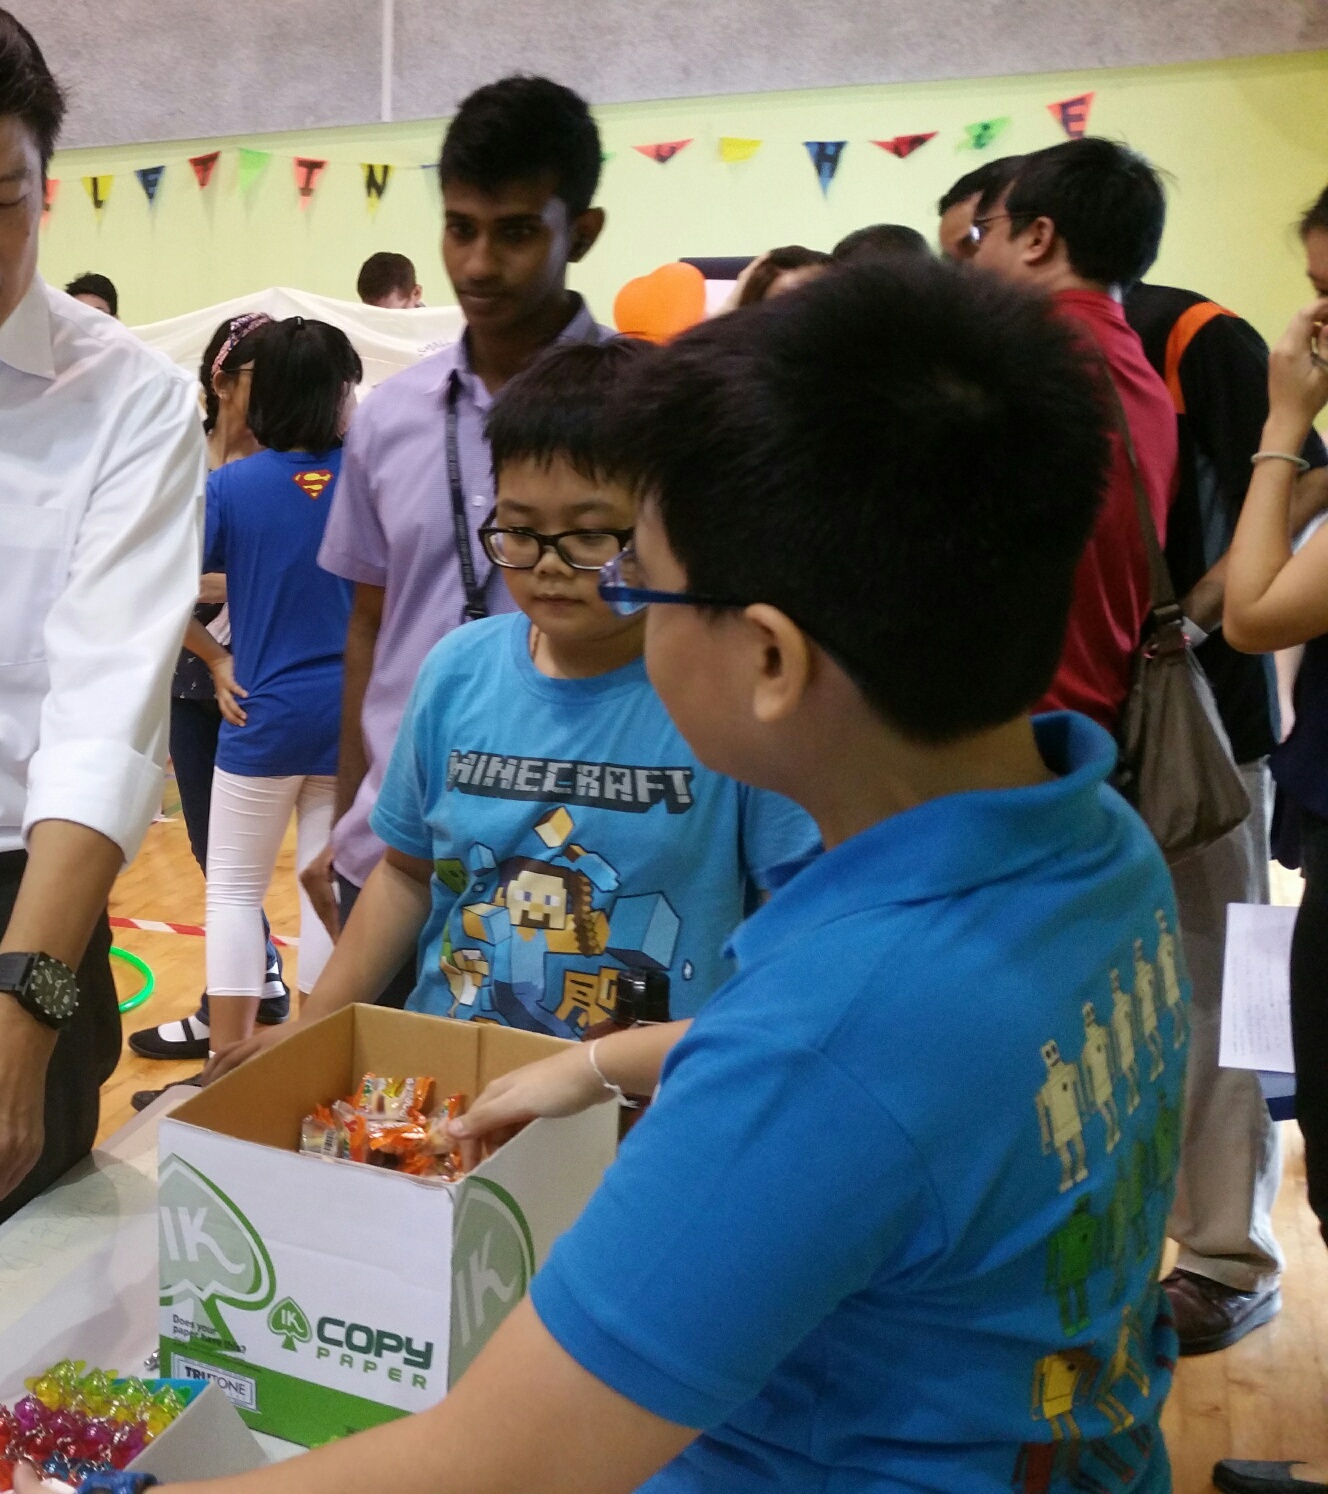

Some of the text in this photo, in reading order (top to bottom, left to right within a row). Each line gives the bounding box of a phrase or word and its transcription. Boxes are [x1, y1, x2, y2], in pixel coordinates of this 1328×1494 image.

[446, 749, 692, 810] MINECRAFT
[159, 1206, 246, 1275] IK
[172, 1313, 195, 1329] Does
[281, 1309, 305, 1333] IK
[316, 1316, 434, 1371] COPY
[316, 1345, 428, 1391] PAPER
